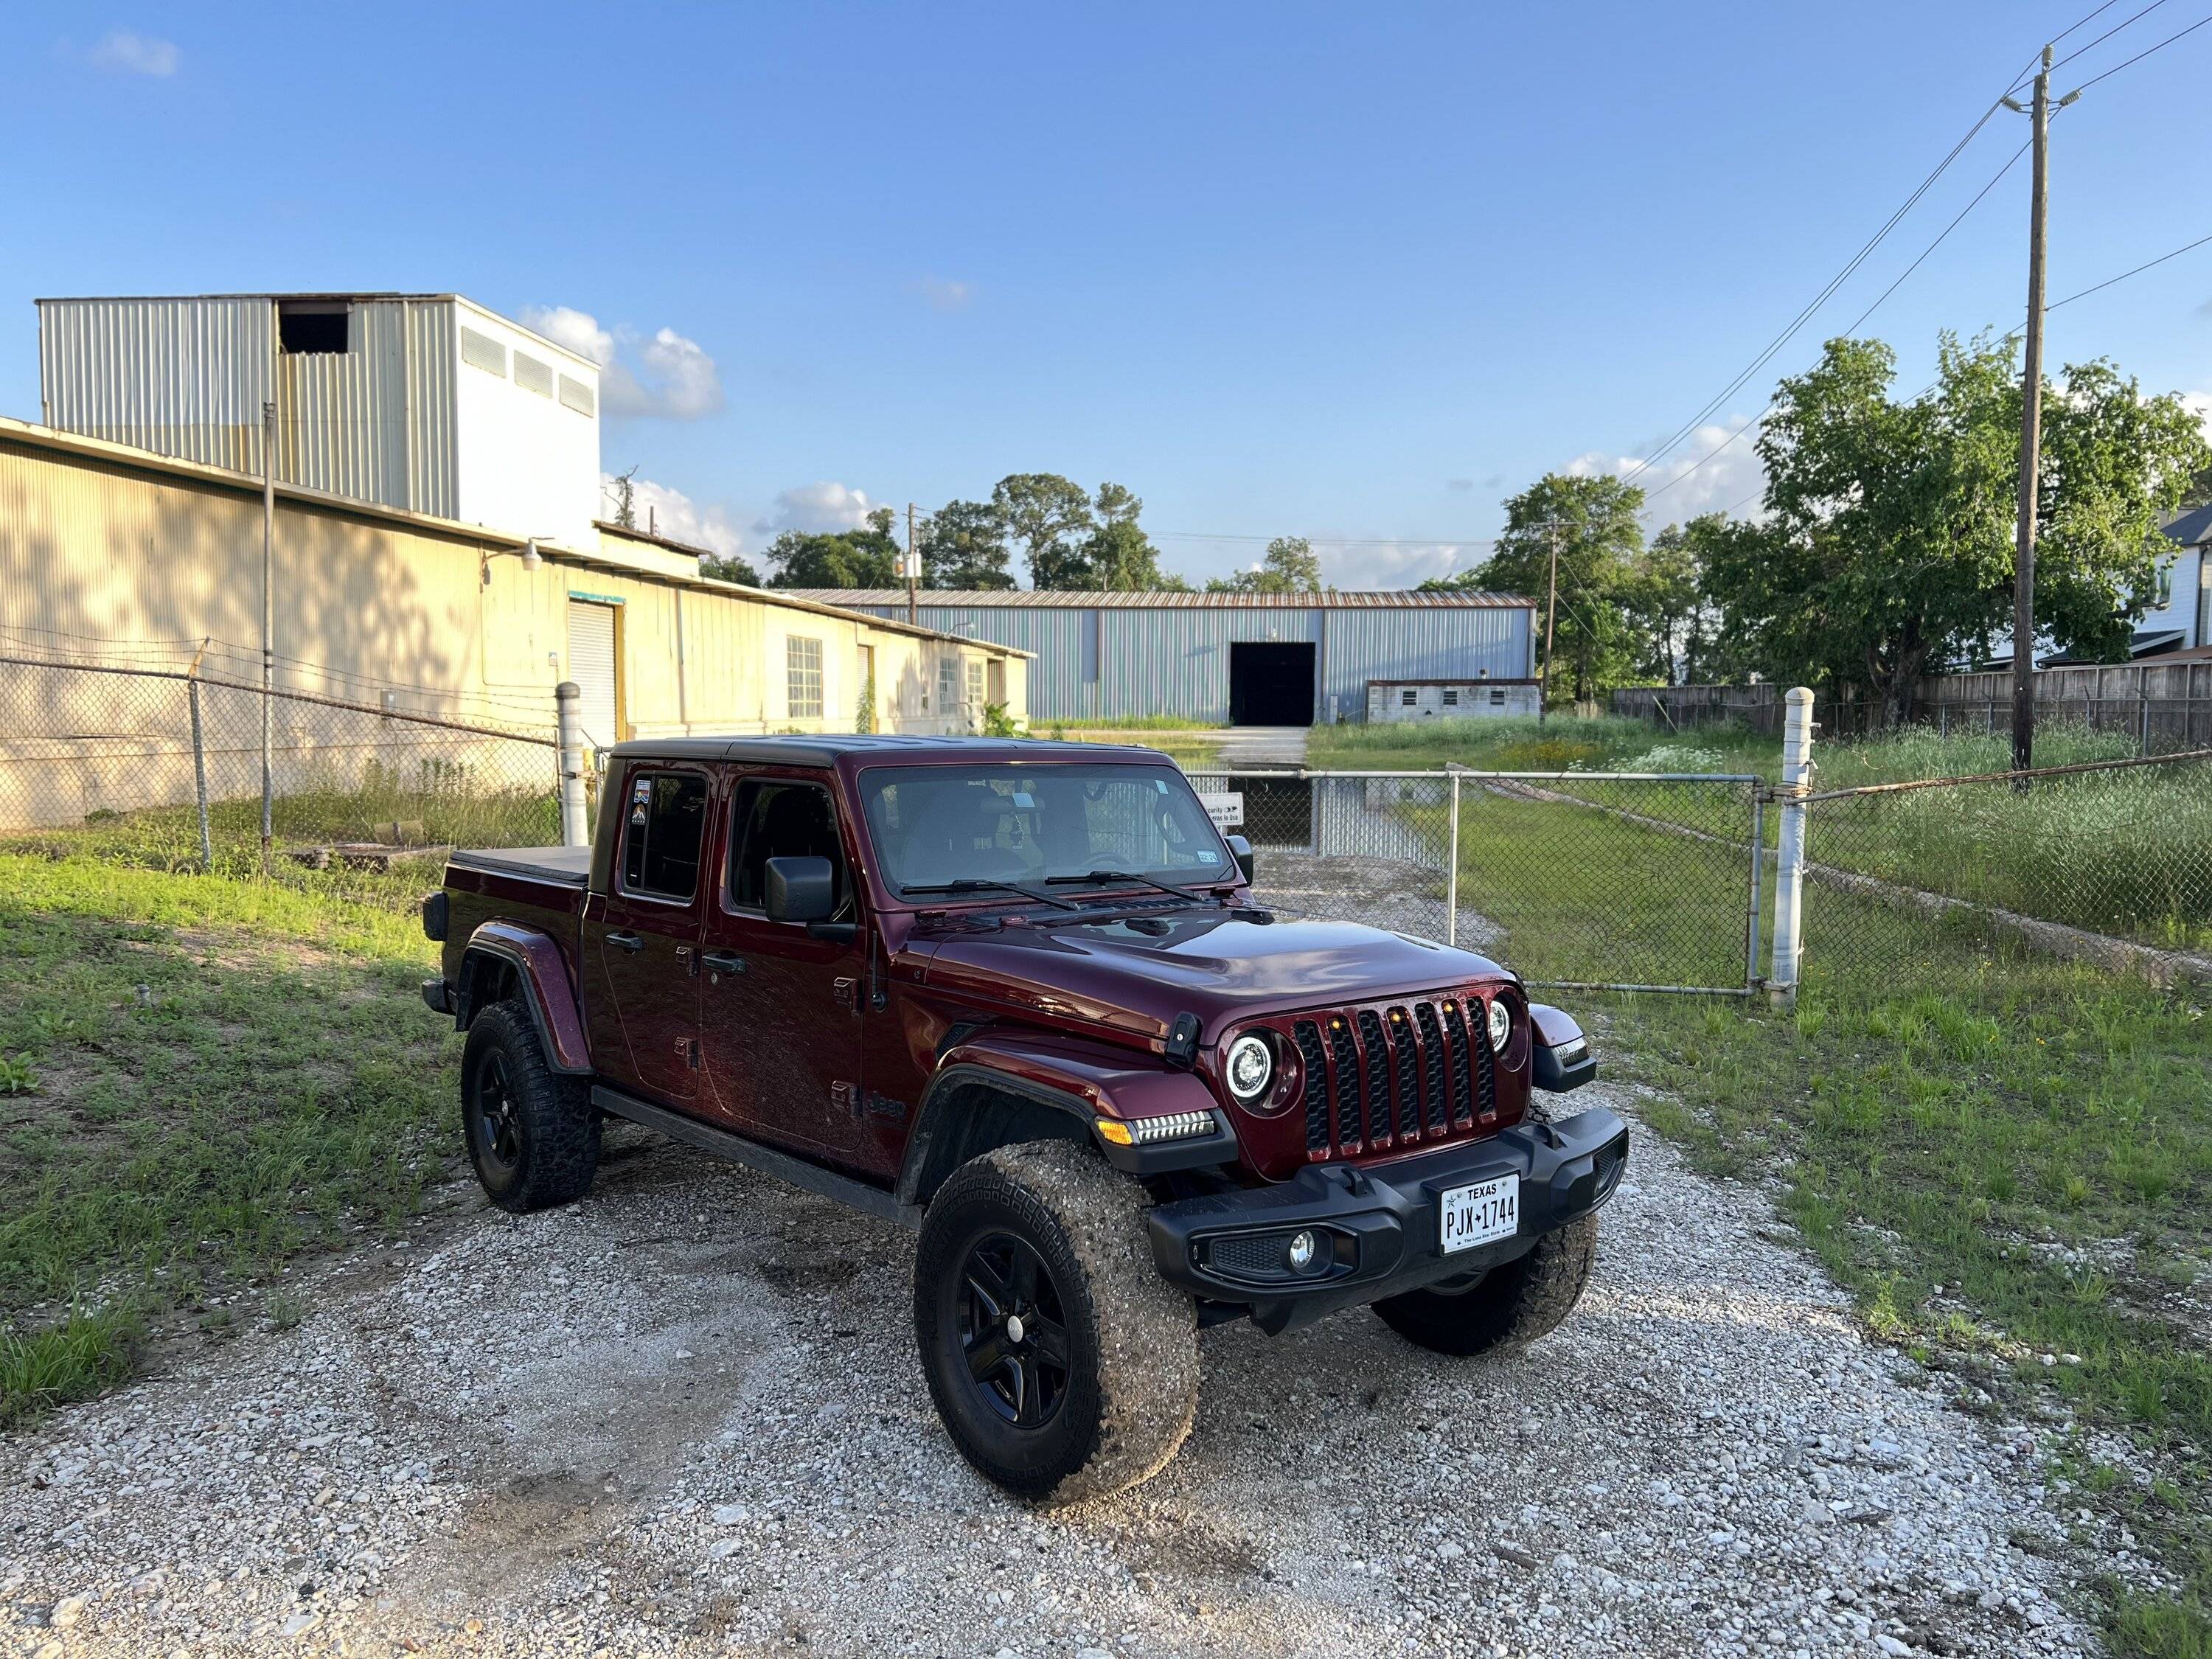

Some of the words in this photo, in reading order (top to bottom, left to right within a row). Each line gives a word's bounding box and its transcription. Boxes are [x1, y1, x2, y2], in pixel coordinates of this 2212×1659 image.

[869, 1091, 905, 1120] Jeep
[1468, 1183, 1496, 1200] TEXAS
[1482, 1196, 1514, 1229] 1744
